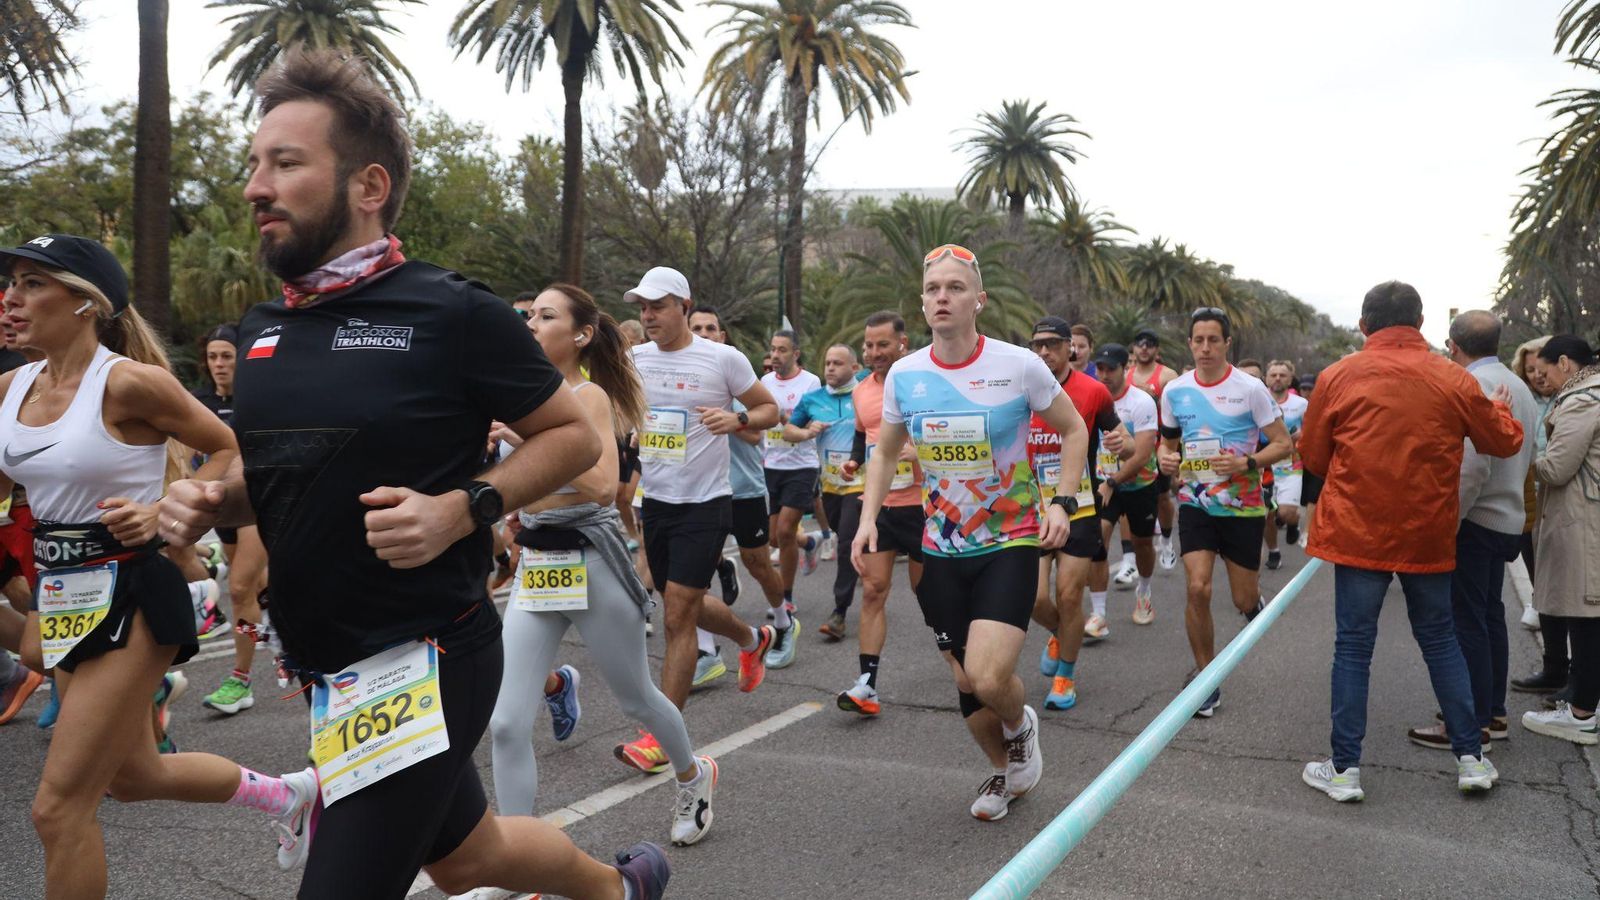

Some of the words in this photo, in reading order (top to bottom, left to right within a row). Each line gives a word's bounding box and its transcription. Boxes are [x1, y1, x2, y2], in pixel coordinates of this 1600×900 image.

[30, 236, 55, 248] KA
[338, 328, 409, 337] BYDGOSZCZ
[336, 337, 407, 347] TRIATHLON
[645, 435, 676, 449] 1476
[1027, 433, 1062, 444] ARTA
[931, 445, 978, 461] 3583
[1187, 460, 1210, 471] 159
[527, 569, 573, 589] 3368
[43, 612, 96, 640] 3361
[338, 692, 414, 752] 1652
